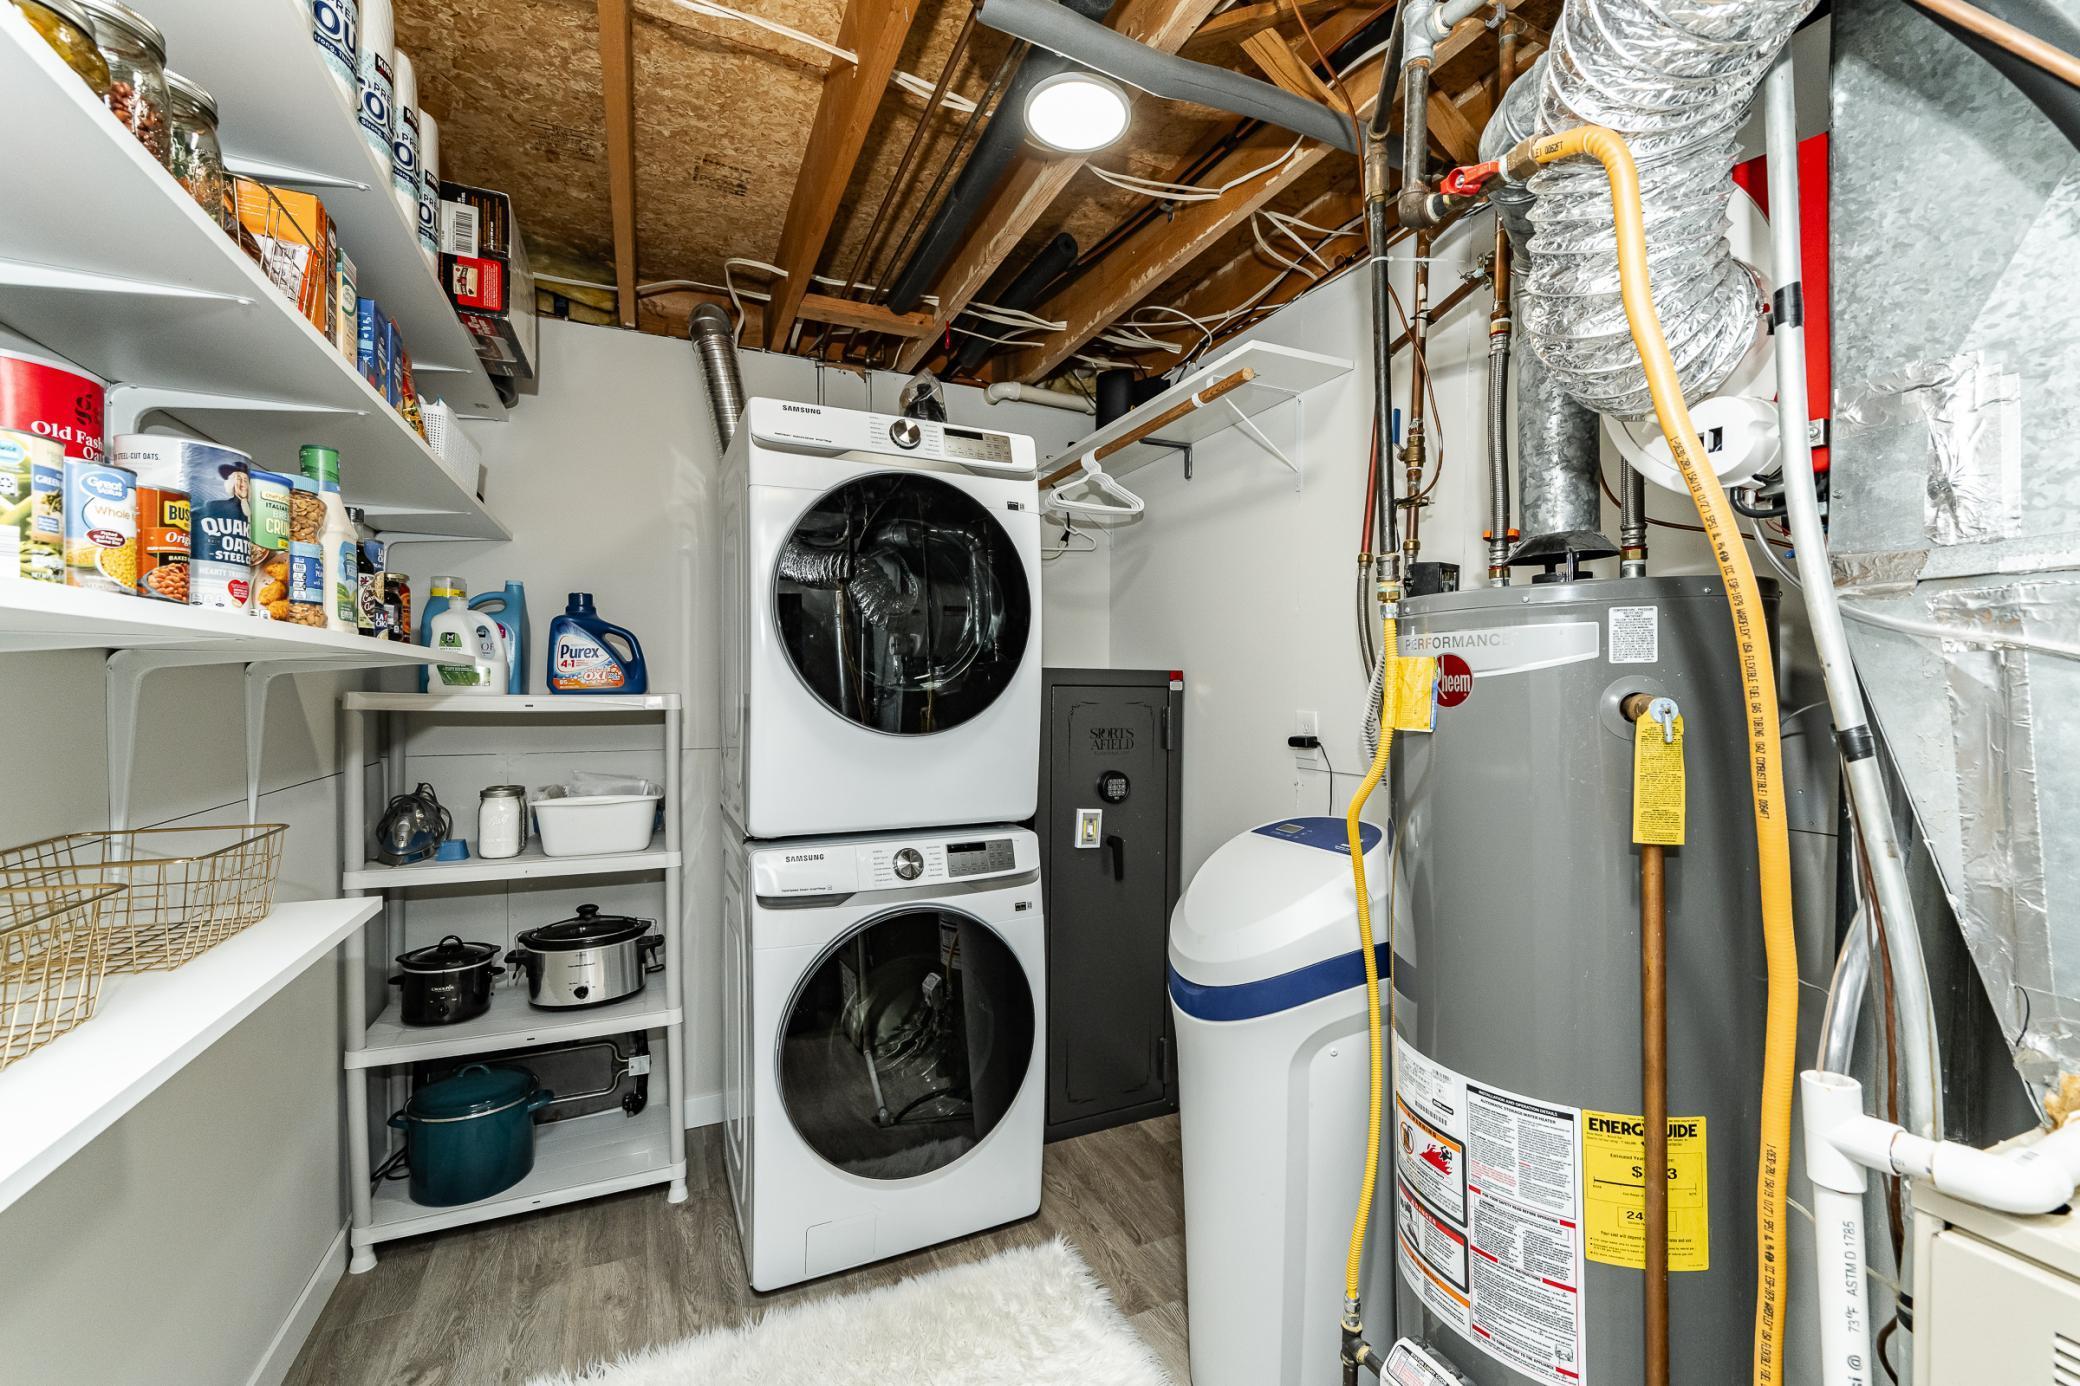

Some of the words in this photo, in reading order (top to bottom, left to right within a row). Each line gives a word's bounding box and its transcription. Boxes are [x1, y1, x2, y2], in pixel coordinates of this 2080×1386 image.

[782, 404, 821, 415] SAMSUNG
[31, 420, 73, 440] Old
[95, 506, 131, 520] Whole
[215, 551, 246, 564] STEEL
[560, 644, 599, 659] Purex
[584, 671, 607, 681] OXI
[1744, 655, 1758, 683] FLEXIBLE
[1748, 685, 1760, 700] FUEL
[1751, 703, 1762, 714] GAS
[1089, 727, 1135, 739] SPORTS
[1753, 716, 1764, 737] TUBING
[1091, 738, 1135, 750] AFIELD
[785, 853, 825, 863] SAMSUNG
[1842, 1220, 1856, 1247] 1785
[1845, 1251, 1857, 1260] D
[1845, 1263, 1858, 1297] ASTM
[1847, 1354, 1862, 1371] @
